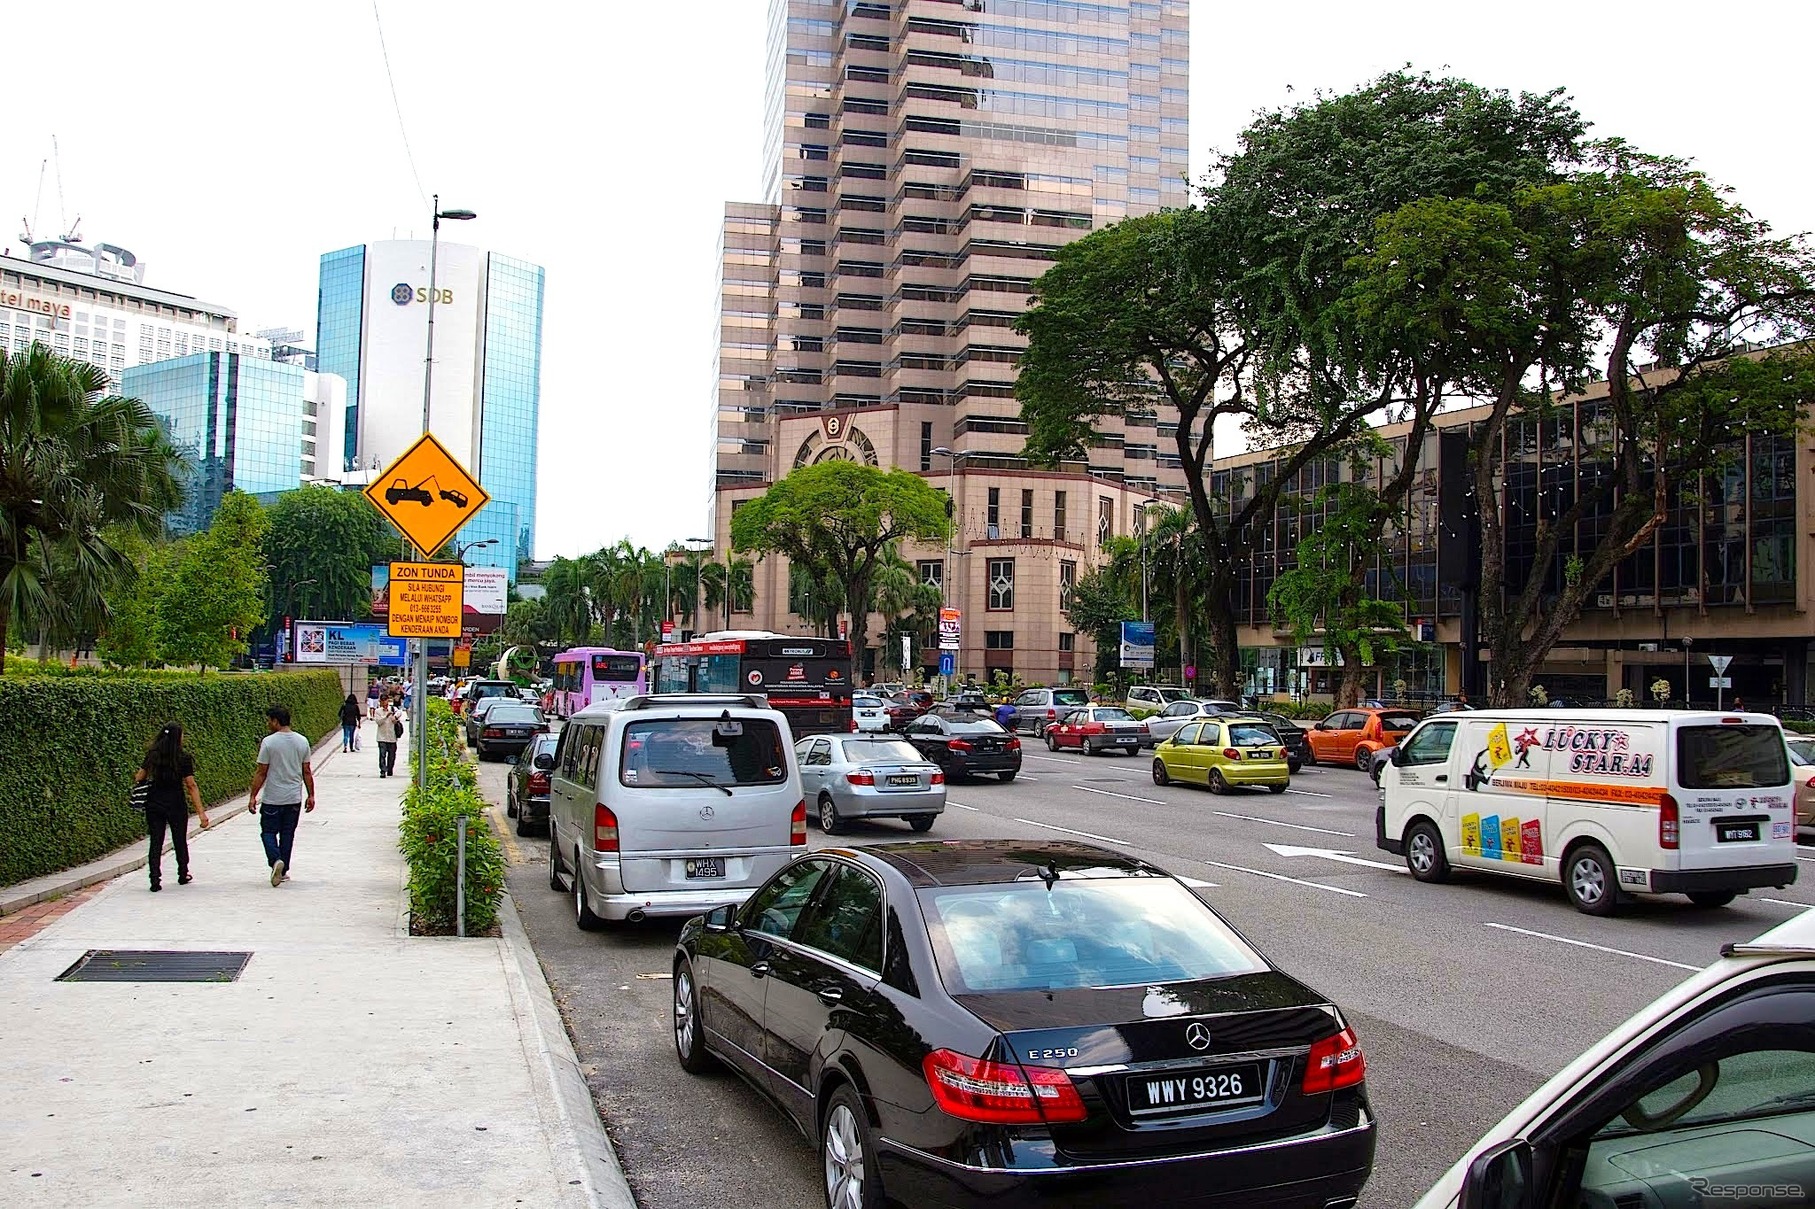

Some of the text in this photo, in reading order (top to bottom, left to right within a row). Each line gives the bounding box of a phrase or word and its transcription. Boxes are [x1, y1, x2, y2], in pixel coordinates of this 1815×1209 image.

[416, 287, 454, 305] SDB
[27, 298, 70, 330] maya
[396, 567, 456, 579] ZON TUNDA
[407, 583, 445, 593] SILA HUBUNGI
[400, 593, 452, 604] MELALUI WHATSAPP
[391, 614, 459, 625] DENGAN MENAIP NOMBOR
[328, 630, 345, 640] KL
[401, 625, 450, 634] KENDERAAN ANDA
[1542, 727, 1616, 752] LUCKY
[695, 858, 716, 868] WHX
[695, 867, 717, 877] 1495
[1028, 1047, 1079, 1059] E 250
[1146, 1073, 1243, 1105] WWY 9326
